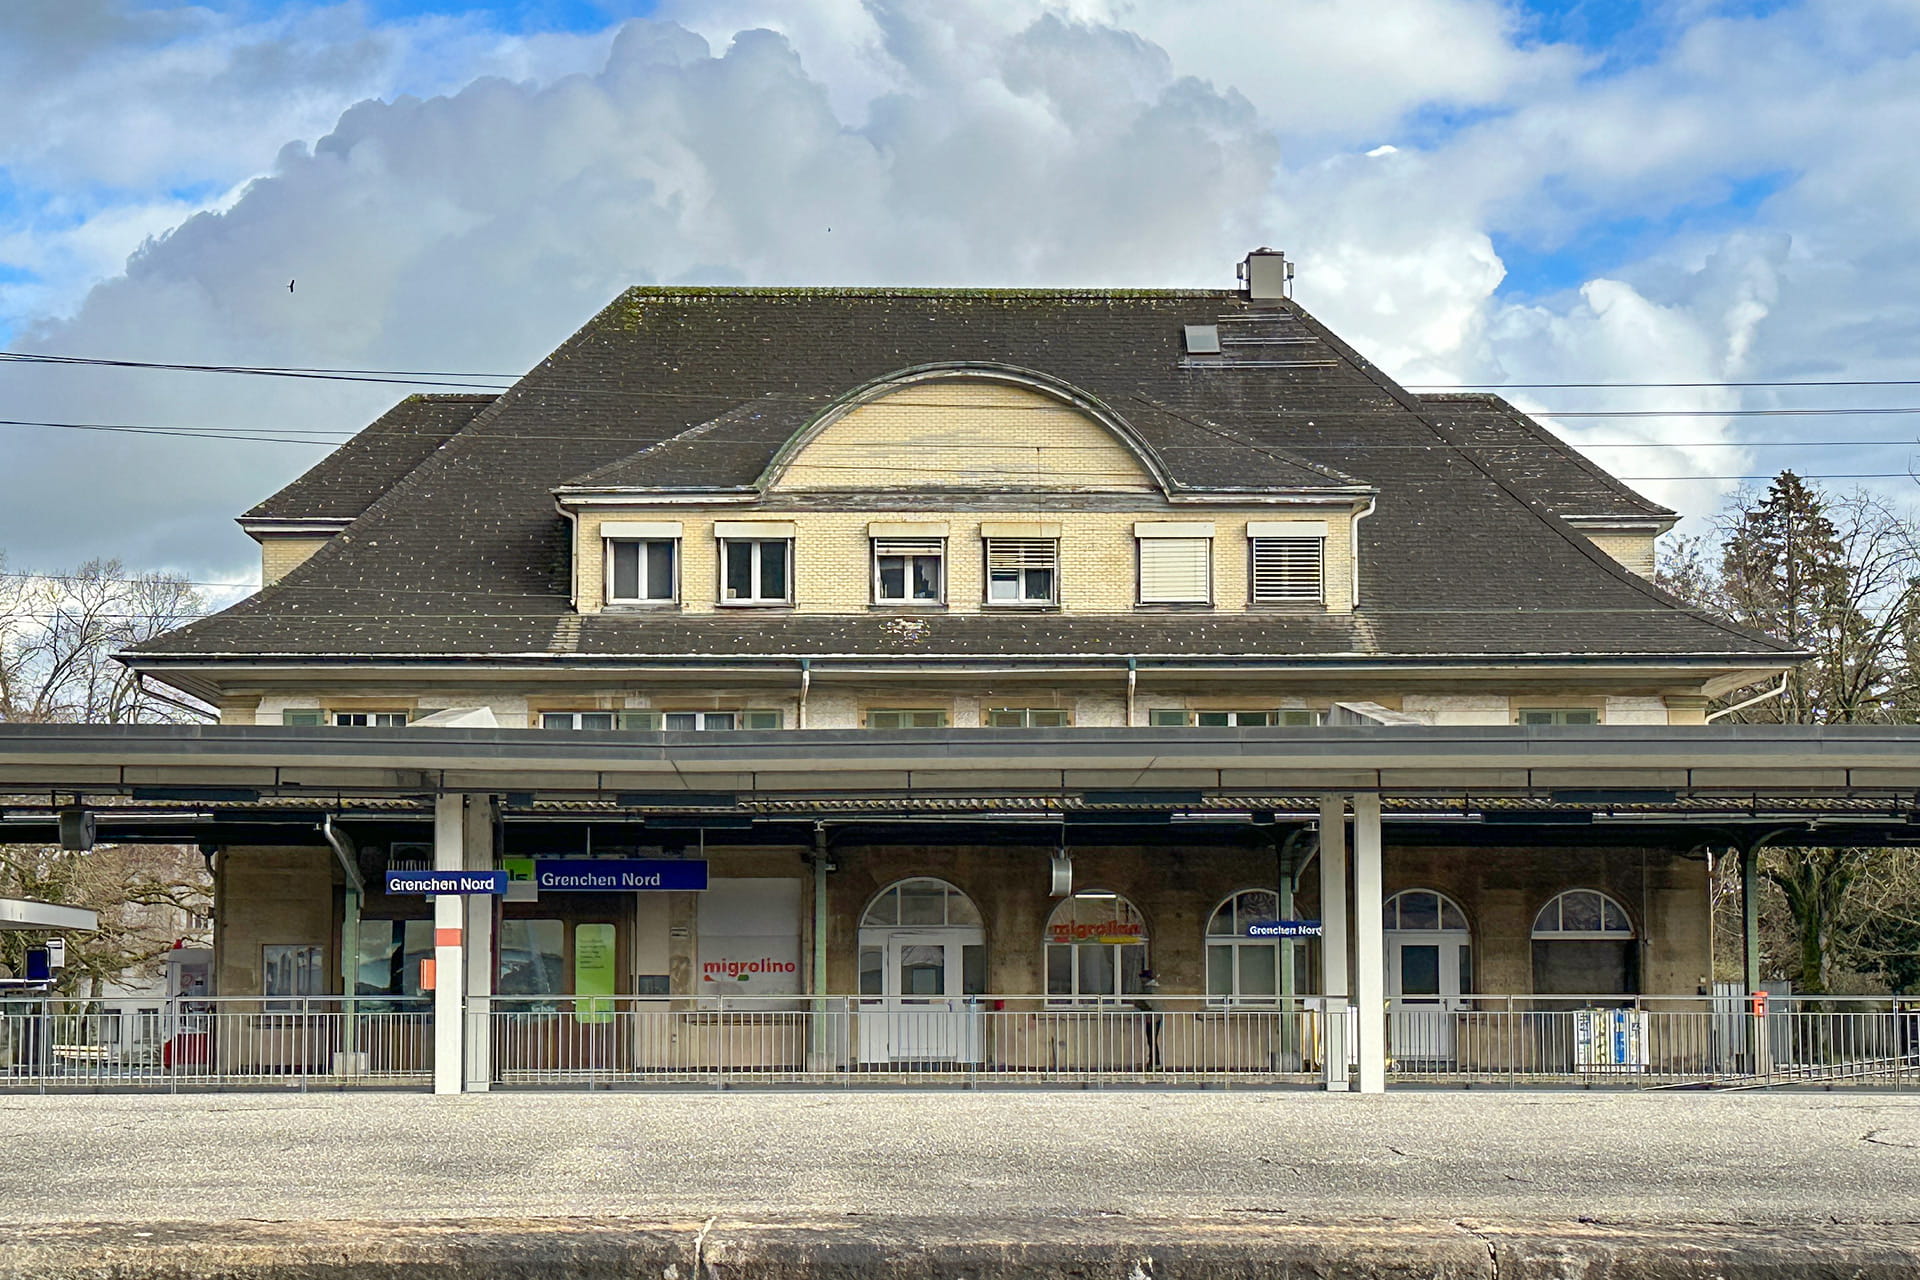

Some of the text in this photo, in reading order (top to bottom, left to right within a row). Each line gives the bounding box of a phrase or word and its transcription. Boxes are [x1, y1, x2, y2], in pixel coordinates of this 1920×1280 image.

[390, 877, 494, 891] Grenchen Nord
[542, 872, 617, 886] Grenchen
[622, 872, 661, 886] Nord
[1249, 925, 1296, 935] Grenchen
[703, 957, 796, 978] migrolino
